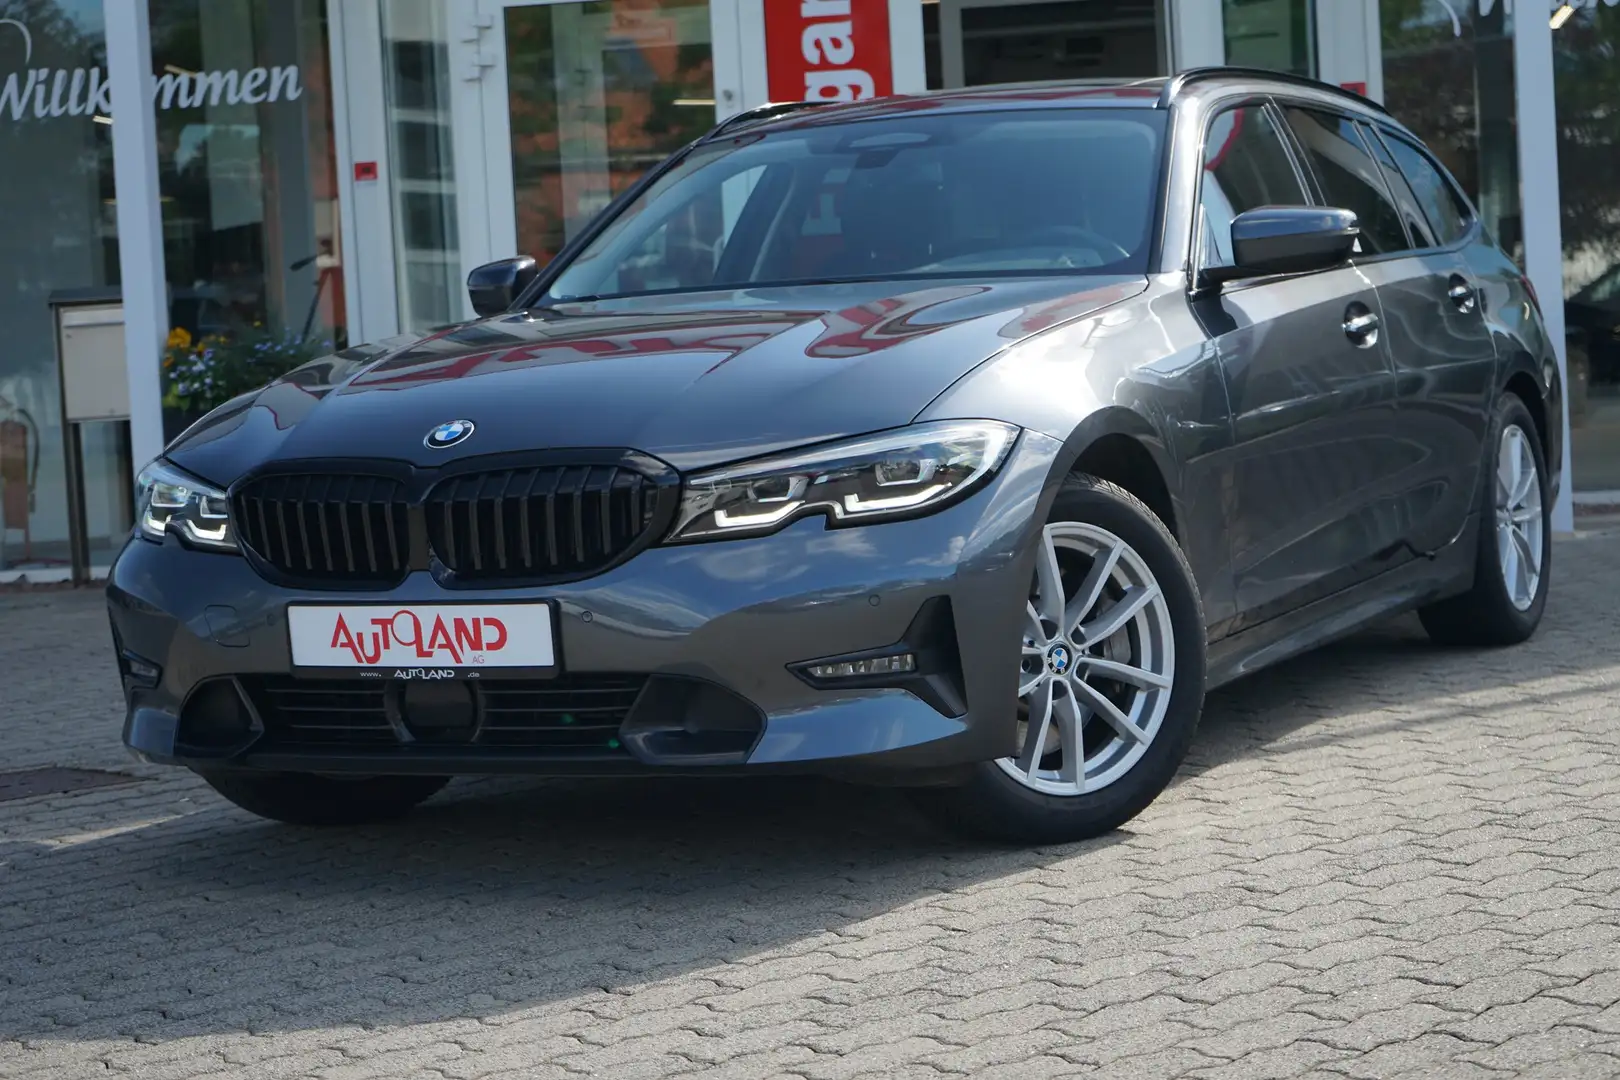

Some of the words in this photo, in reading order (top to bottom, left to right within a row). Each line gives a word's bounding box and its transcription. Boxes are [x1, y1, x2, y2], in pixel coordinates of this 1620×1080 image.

[0, 63, 304, 121] Willkmmen
[331, 609, 508, 665] AUTOLAND
[393, 667, 455, 680] AUTOLAND
[471, 654, 486, 665] AG
